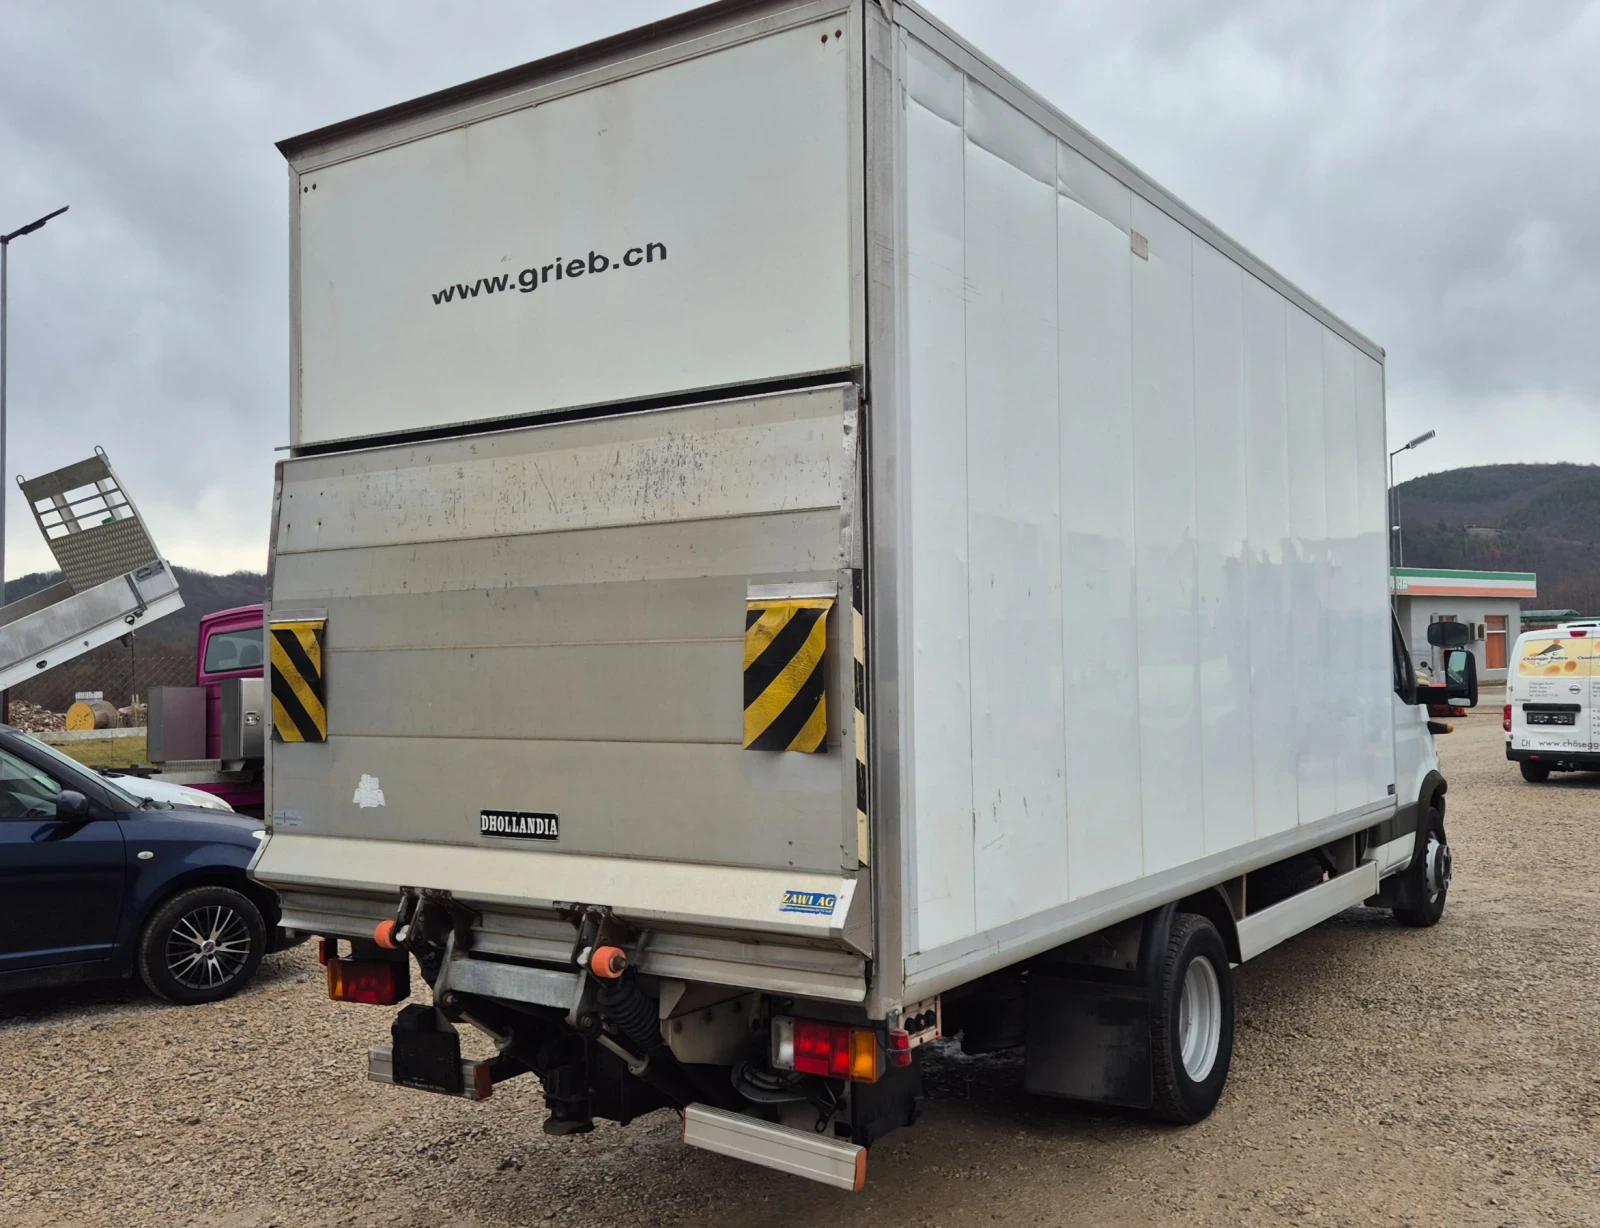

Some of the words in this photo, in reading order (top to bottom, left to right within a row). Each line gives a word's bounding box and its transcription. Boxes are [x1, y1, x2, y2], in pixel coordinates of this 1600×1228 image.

[431, 242, 668, 305] www.grieb.cn
[481, 814, 558, 836] DHOLLANDIA
[782, 893, 814, 906] ZAWI
[816, 896, 835, 907] AG
